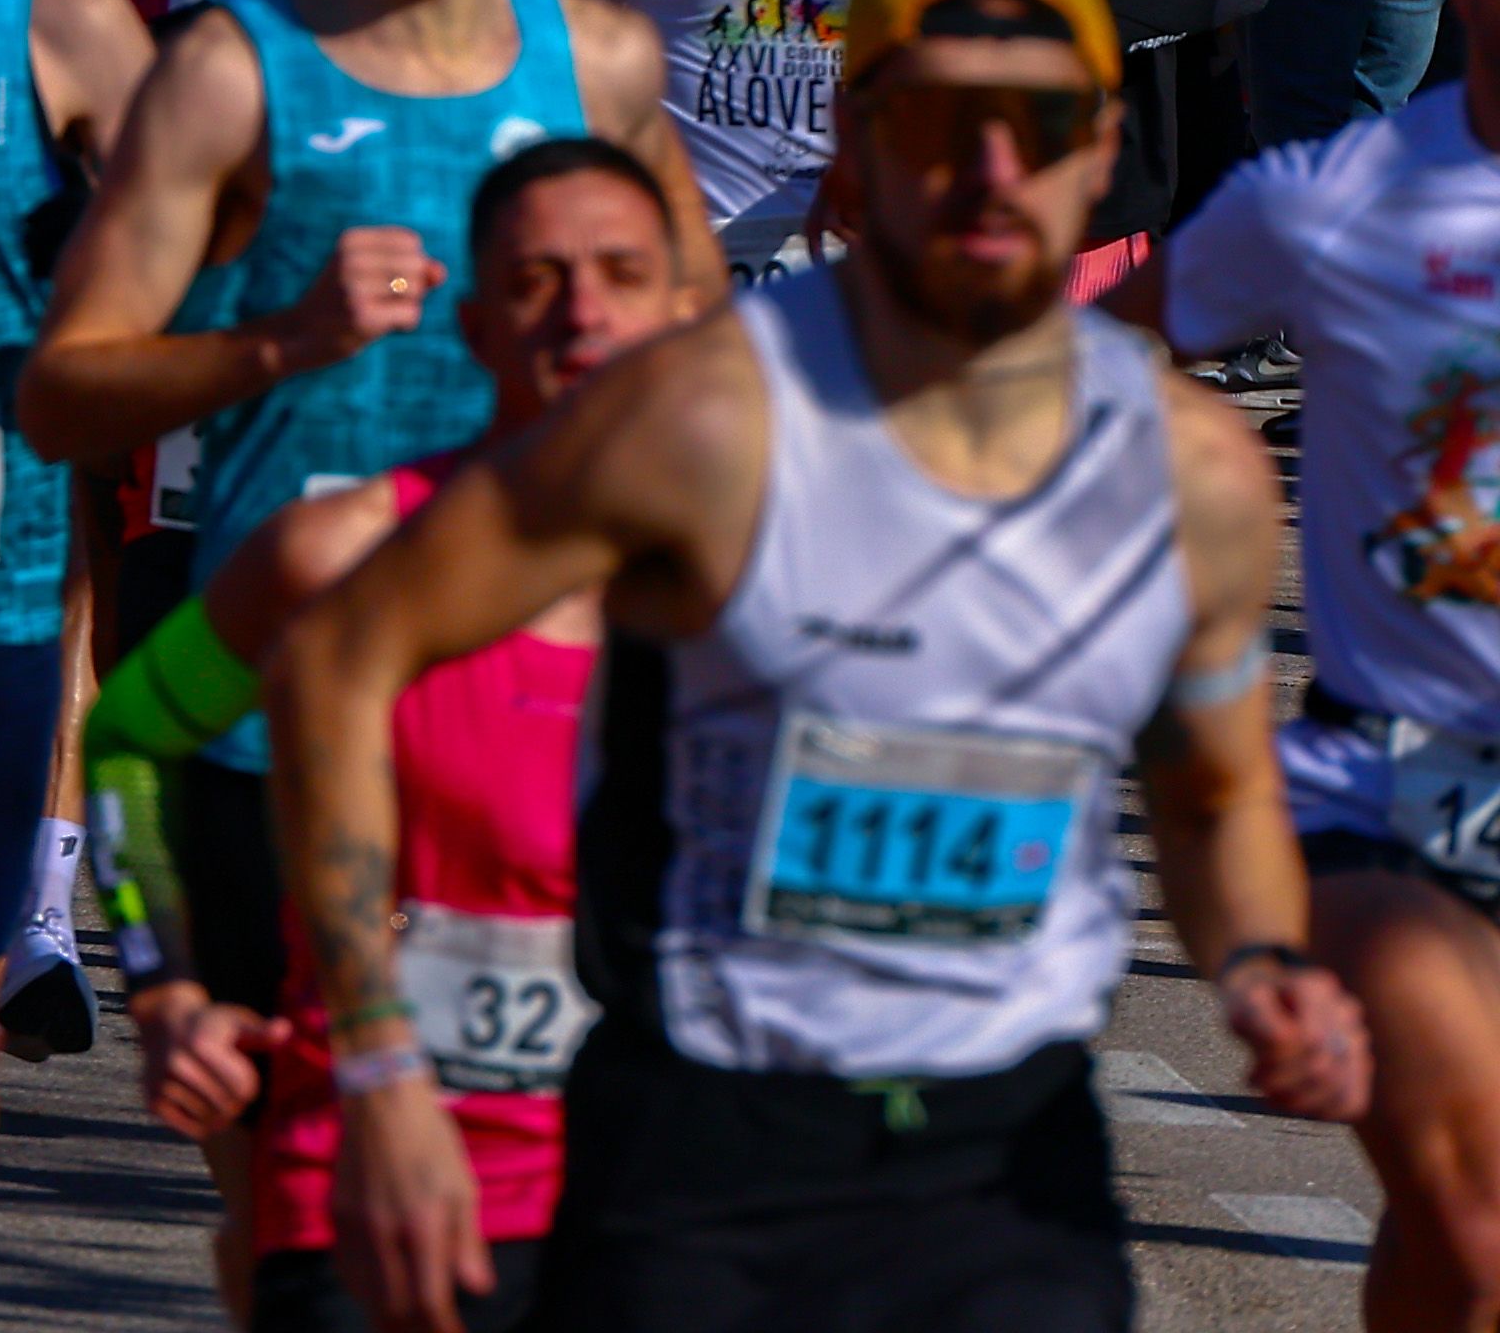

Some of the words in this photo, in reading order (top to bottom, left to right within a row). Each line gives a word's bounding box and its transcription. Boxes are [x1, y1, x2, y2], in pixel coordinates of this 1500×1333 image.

[707, 44, 777, 77] XXVI
[784, 45, 843, 62] carre
[697, 75, 830, 136] ALOVE
[796, 795, 1000, 891] 1114
[460, 976, 564, 1057] 32
